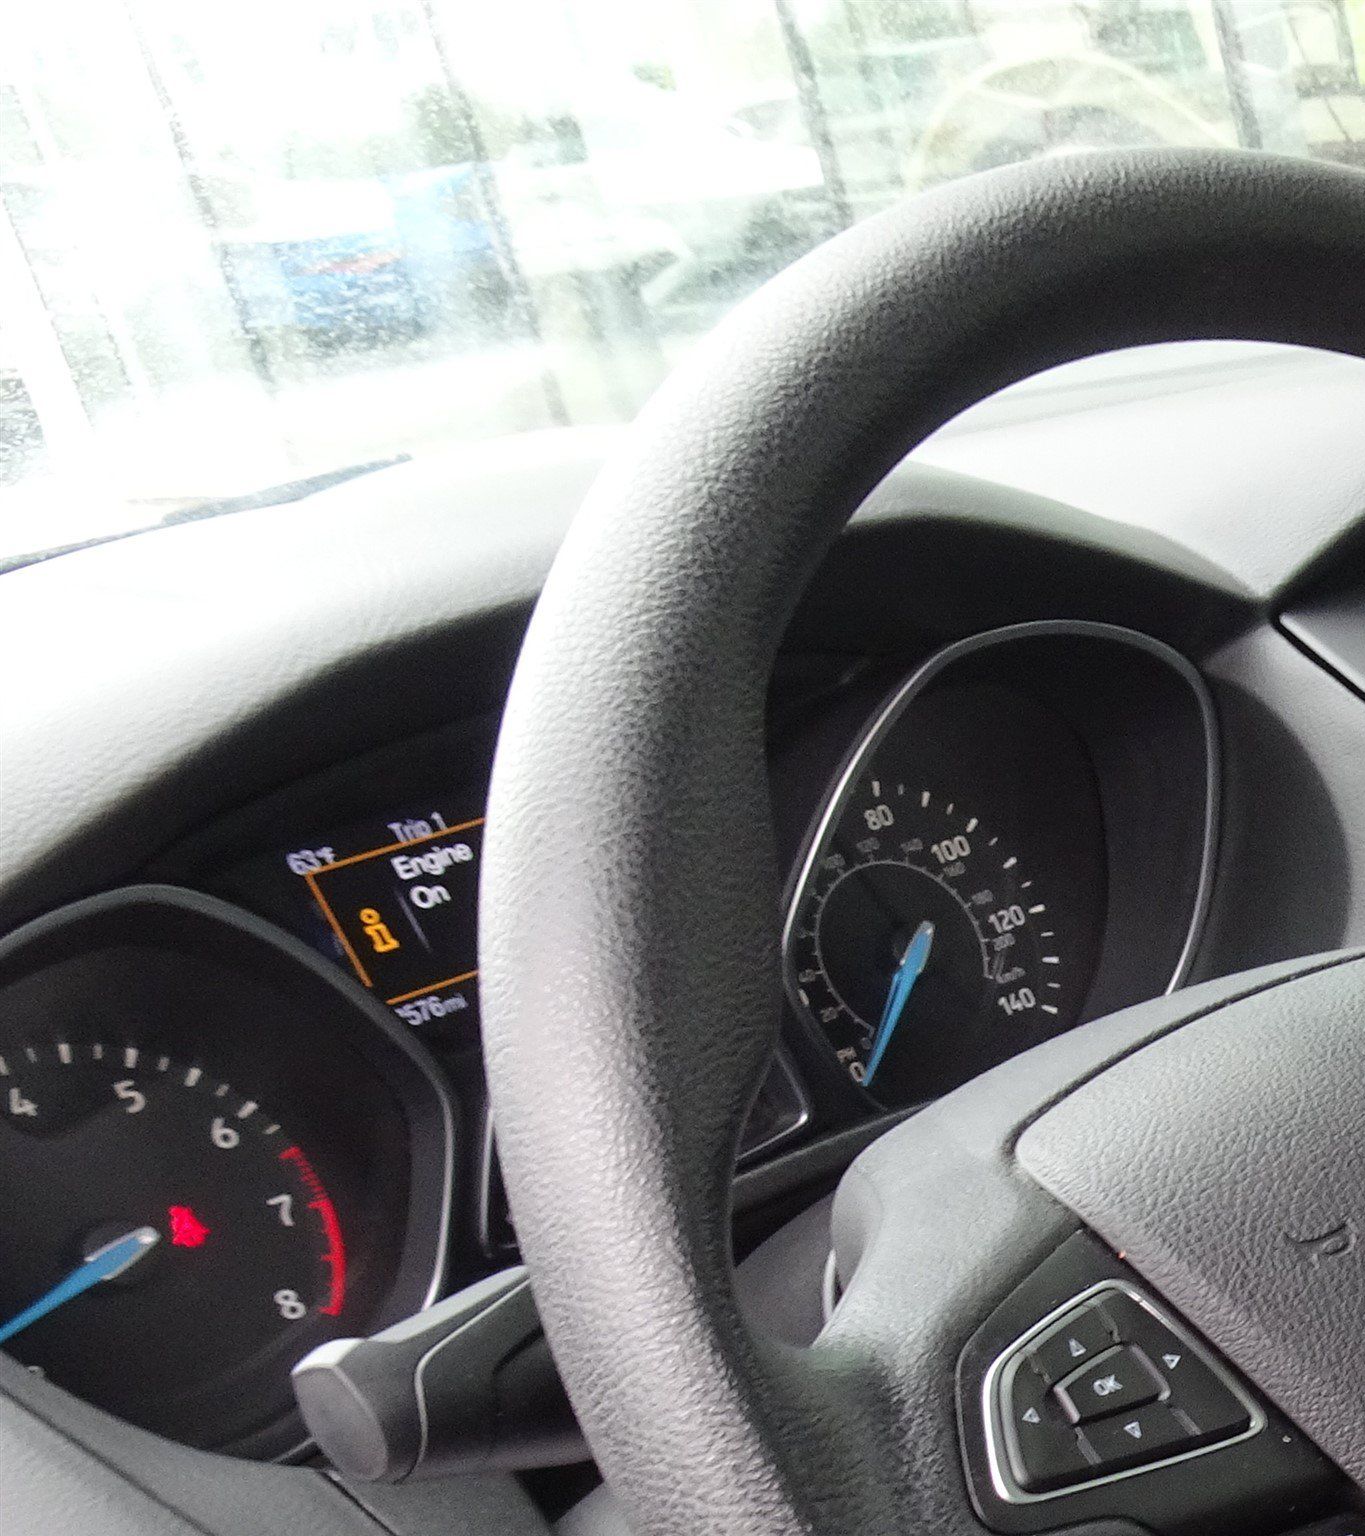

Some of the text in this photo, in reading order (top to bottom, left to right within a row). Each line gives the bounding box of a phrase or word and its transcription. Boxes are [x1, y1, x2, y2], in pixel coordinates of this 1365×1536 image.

[386, 819, 434, 844] Trip
[864, 805, 894, 831] 80
[390, 843, 474, 880] Engine
[931, 835, 971, 863] 100
[410, 884, 451, 909] On
[988, 905, 1026, 933] 120
[998, 988, 1037, 1016] 140
[10, 1087, 38, 1117] 4
[112, 1080, 146, 1113] 5
[211, 1117, 240, 1148] 6
[266, 1193, 295, 1227] 7
[273, 1288, 307, 1319] 8
[1093, 1374, 1123, 1397] OK
